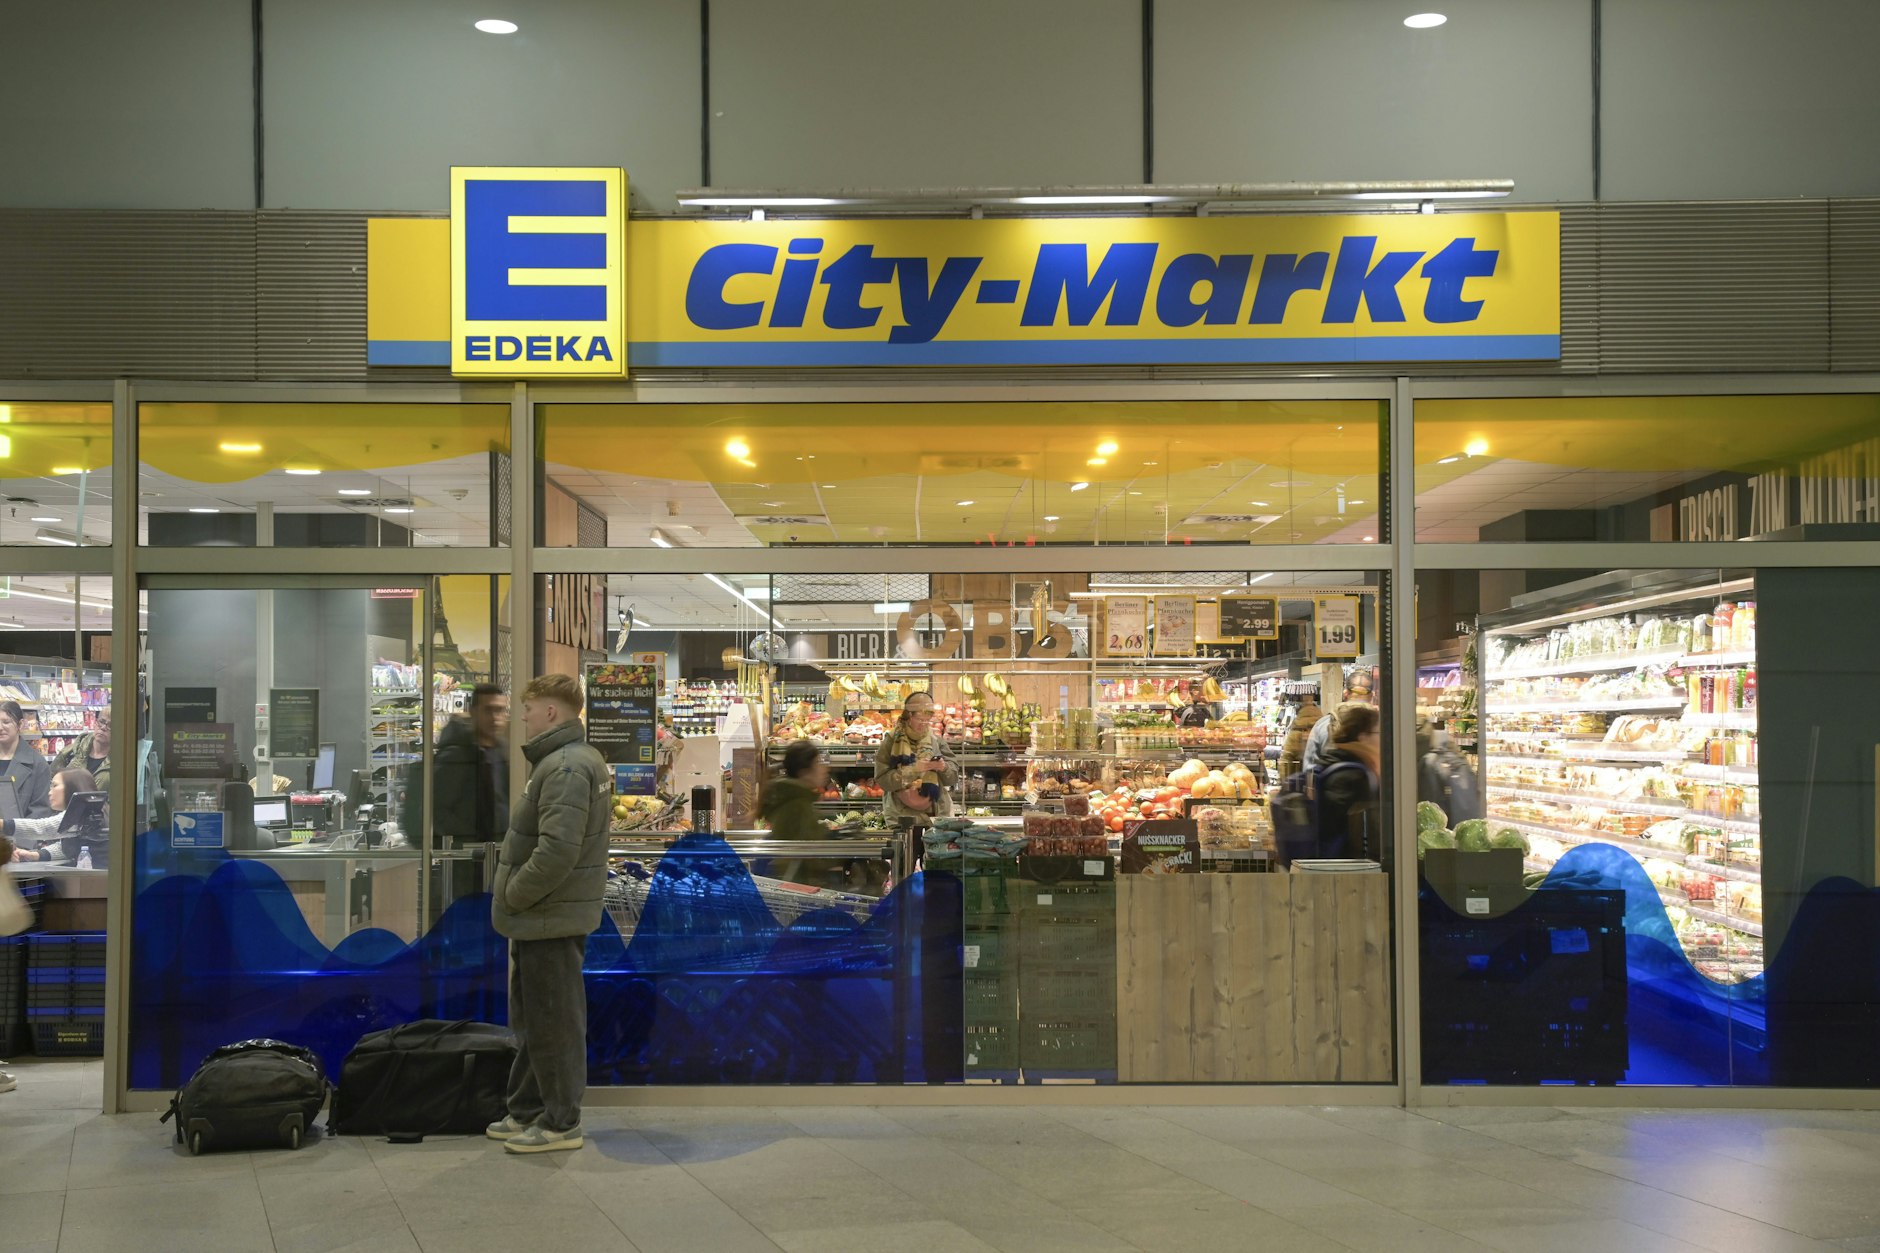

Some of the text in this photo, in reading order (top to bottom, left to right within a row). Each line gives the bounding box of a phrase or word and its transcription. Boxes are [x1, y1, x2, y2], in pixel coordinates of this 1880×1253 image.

[465, 180, 607, 321] E
[685, 236, 1500, 344] City-Markt
[465, 335, 614, 362] EDEKA
[1748, 468, 1788, 536] ZUM
[1243, 618, 1270, 629] 2.99
[1109, 634, 1144, 650] 2,68
[1319, 624, 1356, 644] 1.99
[837, 634, 880, 659] BIER
[589, 687, 654, 697] Wir suchen Dich!
[1137, 834, 1186, 846] NUSSKNACKER
[1164, 850, 1193, 868] CRACK!
